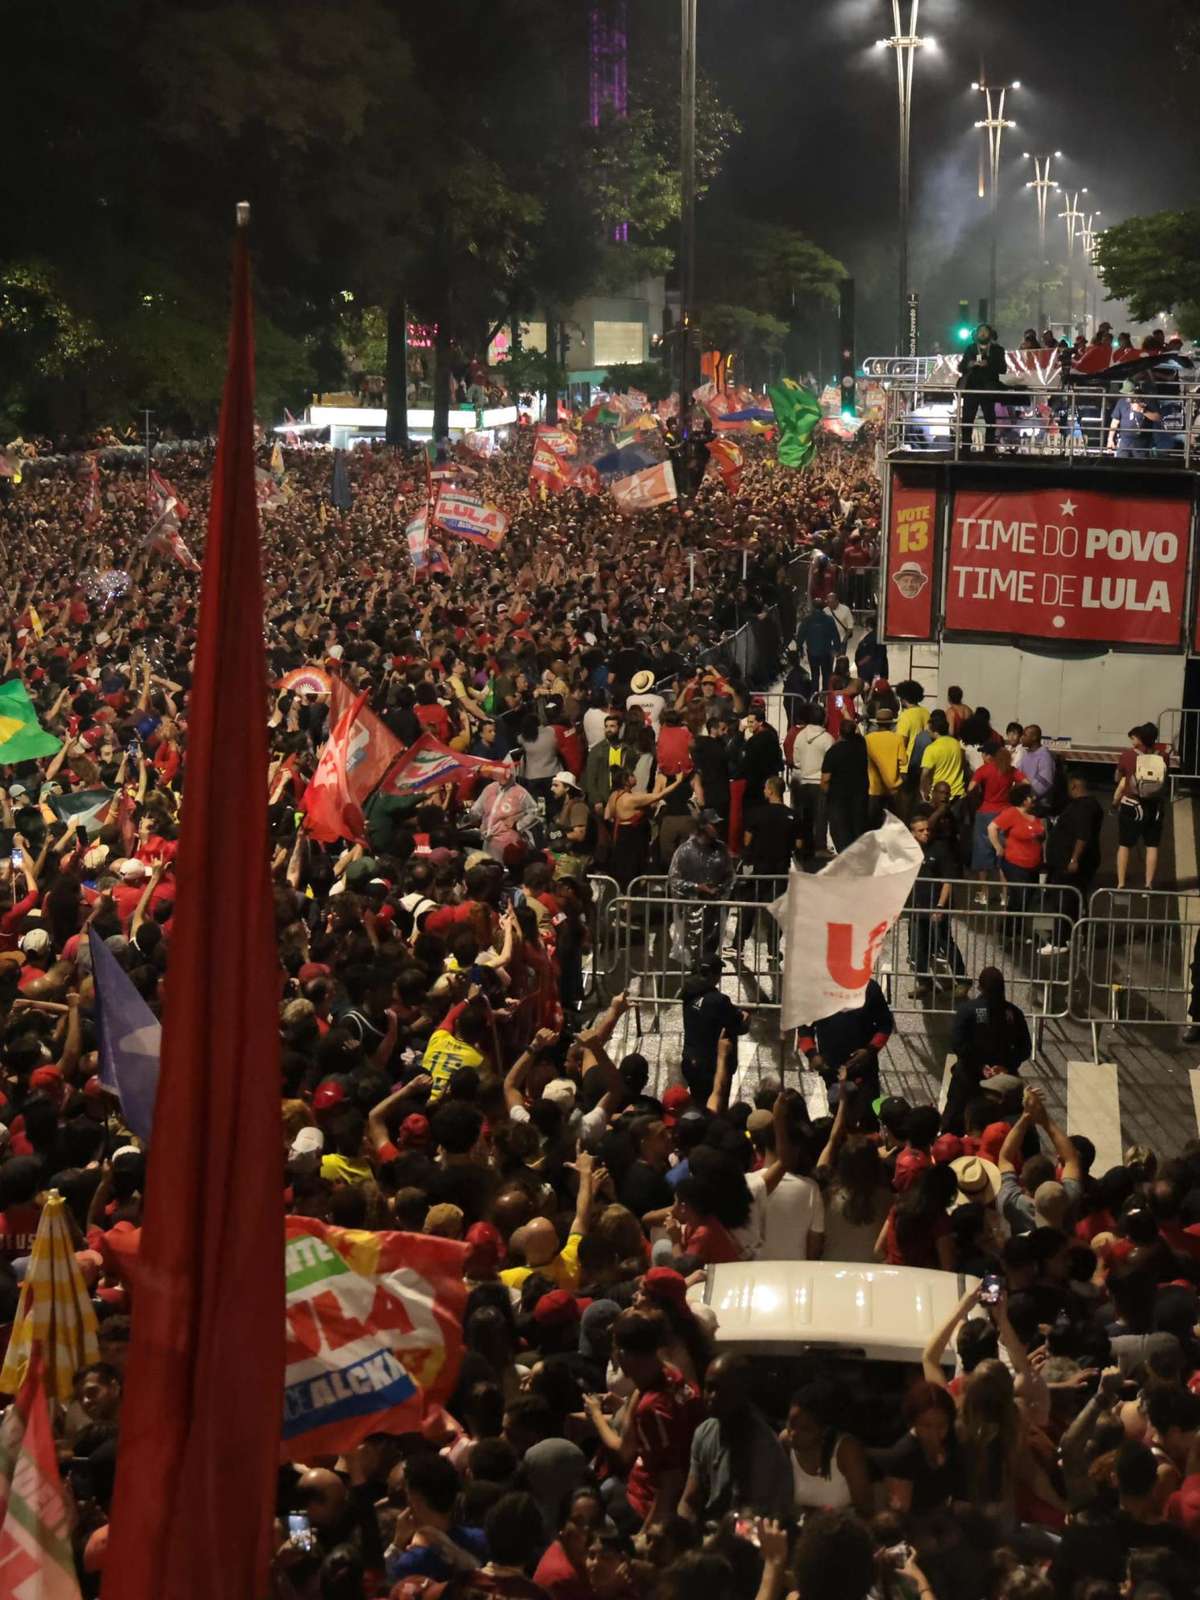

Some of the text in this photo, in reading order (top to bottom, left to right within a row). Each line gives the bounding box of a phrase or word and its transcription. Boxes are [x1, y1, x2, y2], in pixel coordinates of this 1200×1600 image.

[438, 502, 497, 527] LULA
[896, 505, 930, 523] VOTE
[896, 521, 929, 553] 13
[957, 518, 1178, 564] TIME DO POVO
[953, 566, 1171, 613] TIME DE LULA
